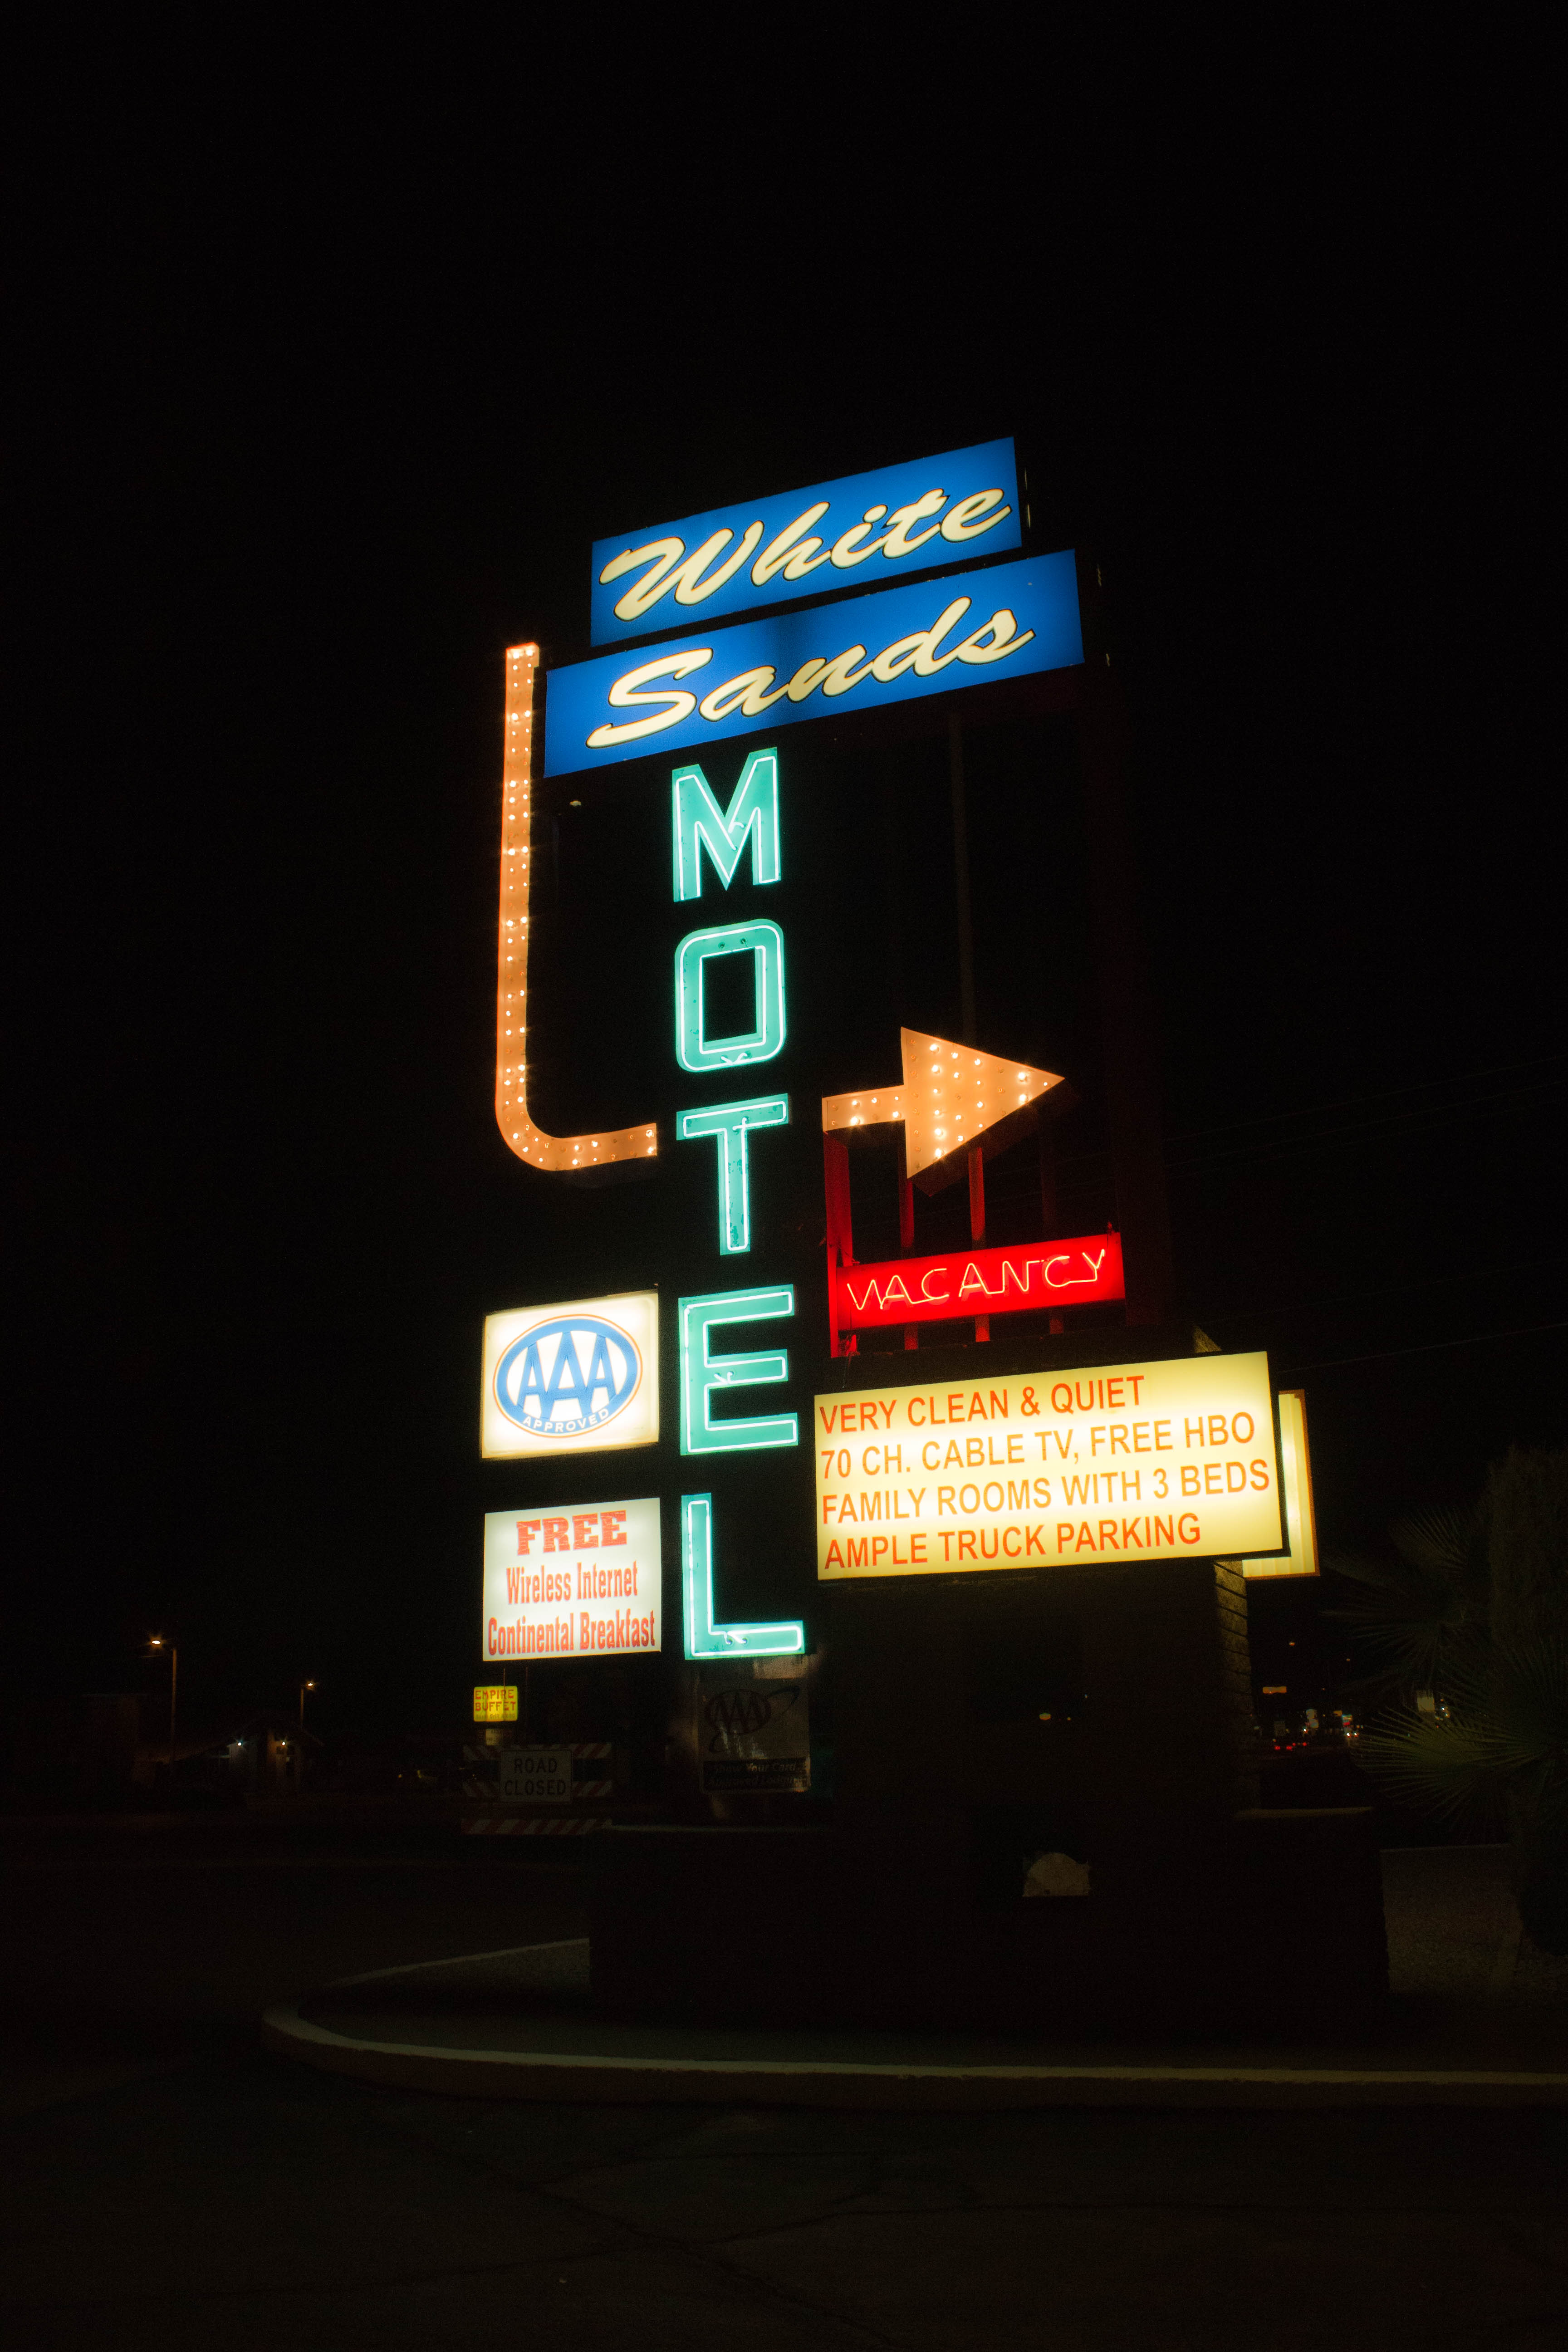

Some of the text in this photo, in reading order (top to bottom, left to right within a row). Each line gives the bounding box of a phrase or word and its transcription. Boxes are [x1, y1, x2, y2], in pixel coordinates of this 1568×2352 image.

[598, 487, 1013, 621] White
[585, 596, 1036, 749] Sands
[671, 747, 805, 1661] MOTEL
[847, 1249, 1105, 1310] VACANCY
[515, 1330, 617, 1420] AAA
[522, 1408, 609, 1433] APPROVED
[819, 1375, 1144, 1434] VERY CLEAN & QUIET
[820, 1411, 1254, 1479] 70 CH. CABLE TV, FREE HBO
[823, 1459, 1269, 1525] FAMILY ROOMS WITH 3 BEDS
[516, 1510, 627, 1556] FREE
[824, 1513, 1200, 1569] AMPLE TRUCK PARKING
[506, 1560, 637, 1605] Wireless Internet
[488, 1608, 655, 1656] Continental Breakfast
[475, 1689, 514, 1700] EMPIRE
[475, 1701, 516, 1711] BUFFET
[505, 1780, 566, 1795] CLOSED
[514, 1758, 558, 1774] ROAD
